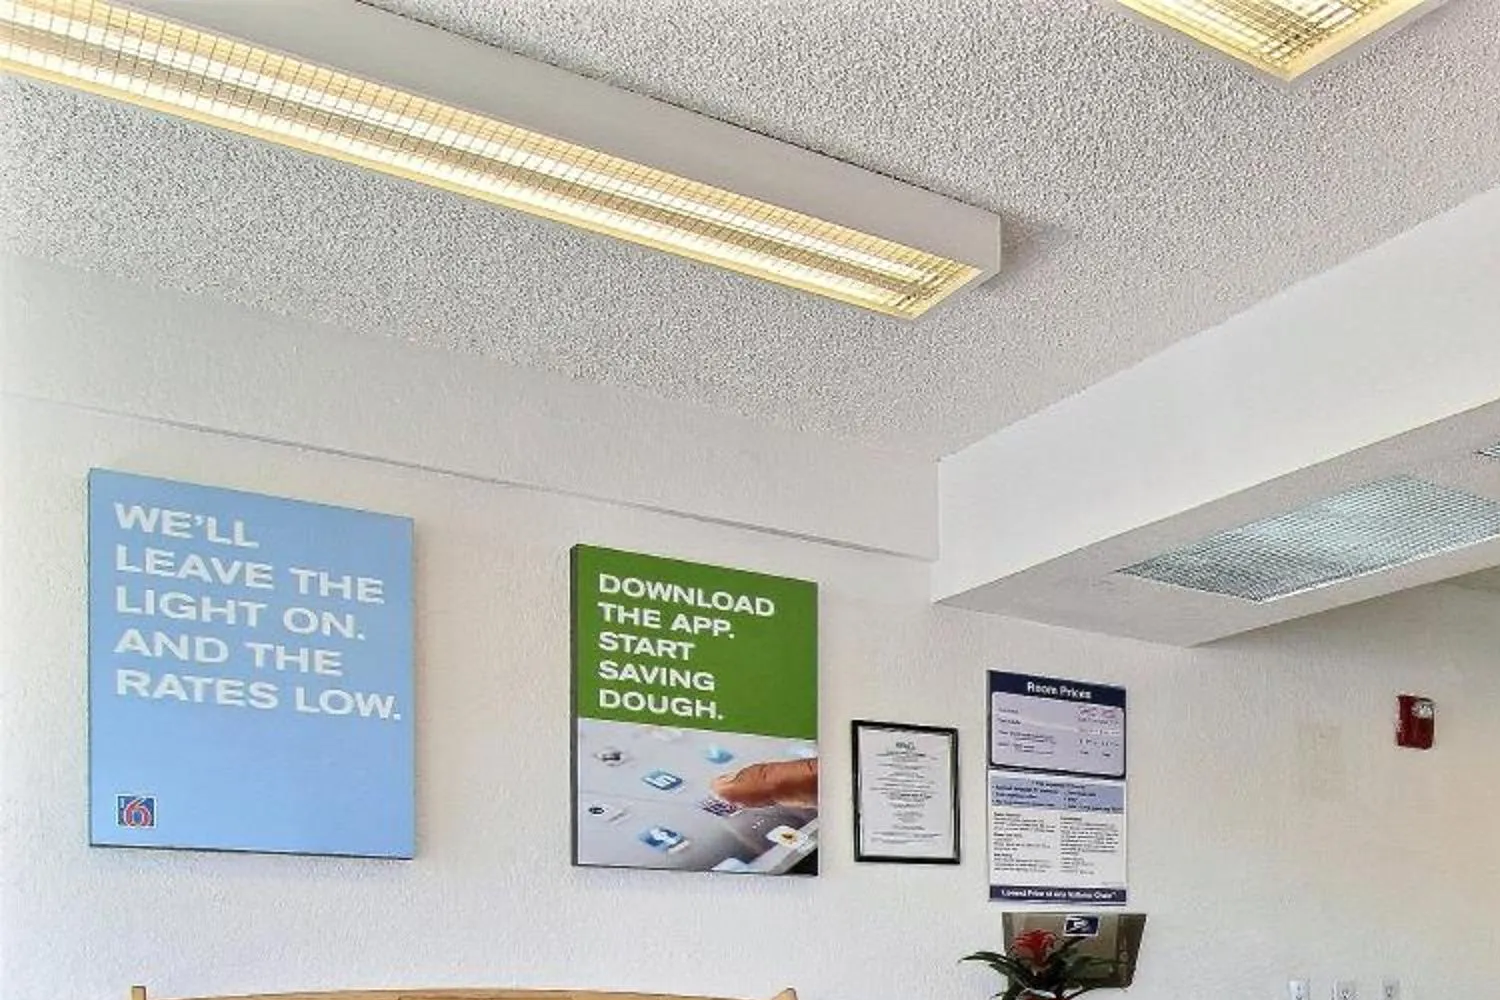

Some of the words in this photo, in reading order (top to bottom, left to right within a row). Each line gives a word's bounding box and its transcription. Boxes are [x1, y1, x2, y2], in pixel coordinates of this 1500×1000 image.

[114, 503, 258, 549] WE'LL
[116, 547, 273, 590] LEAVE
[290, 568, 385, 605] THE
[599, 573, 775, 618] DOWNLOAD
[116, 588, 266, 630] LIGHT
[283, 607, 364, 640] ON.
[599, 603, 662, 631] THE
[670, 610, 735, 639] APP.
[114, 629, 229, 664] AND
[245, 642, 342, 676] THE
[599, 632, 694, 660] START
[116, 669, 278, 709] RATES
[296, 686, 401, 720] LOW.
[599, 660, 714, 692] SAVING
[599, 689, 723, 720] DOUGH.
